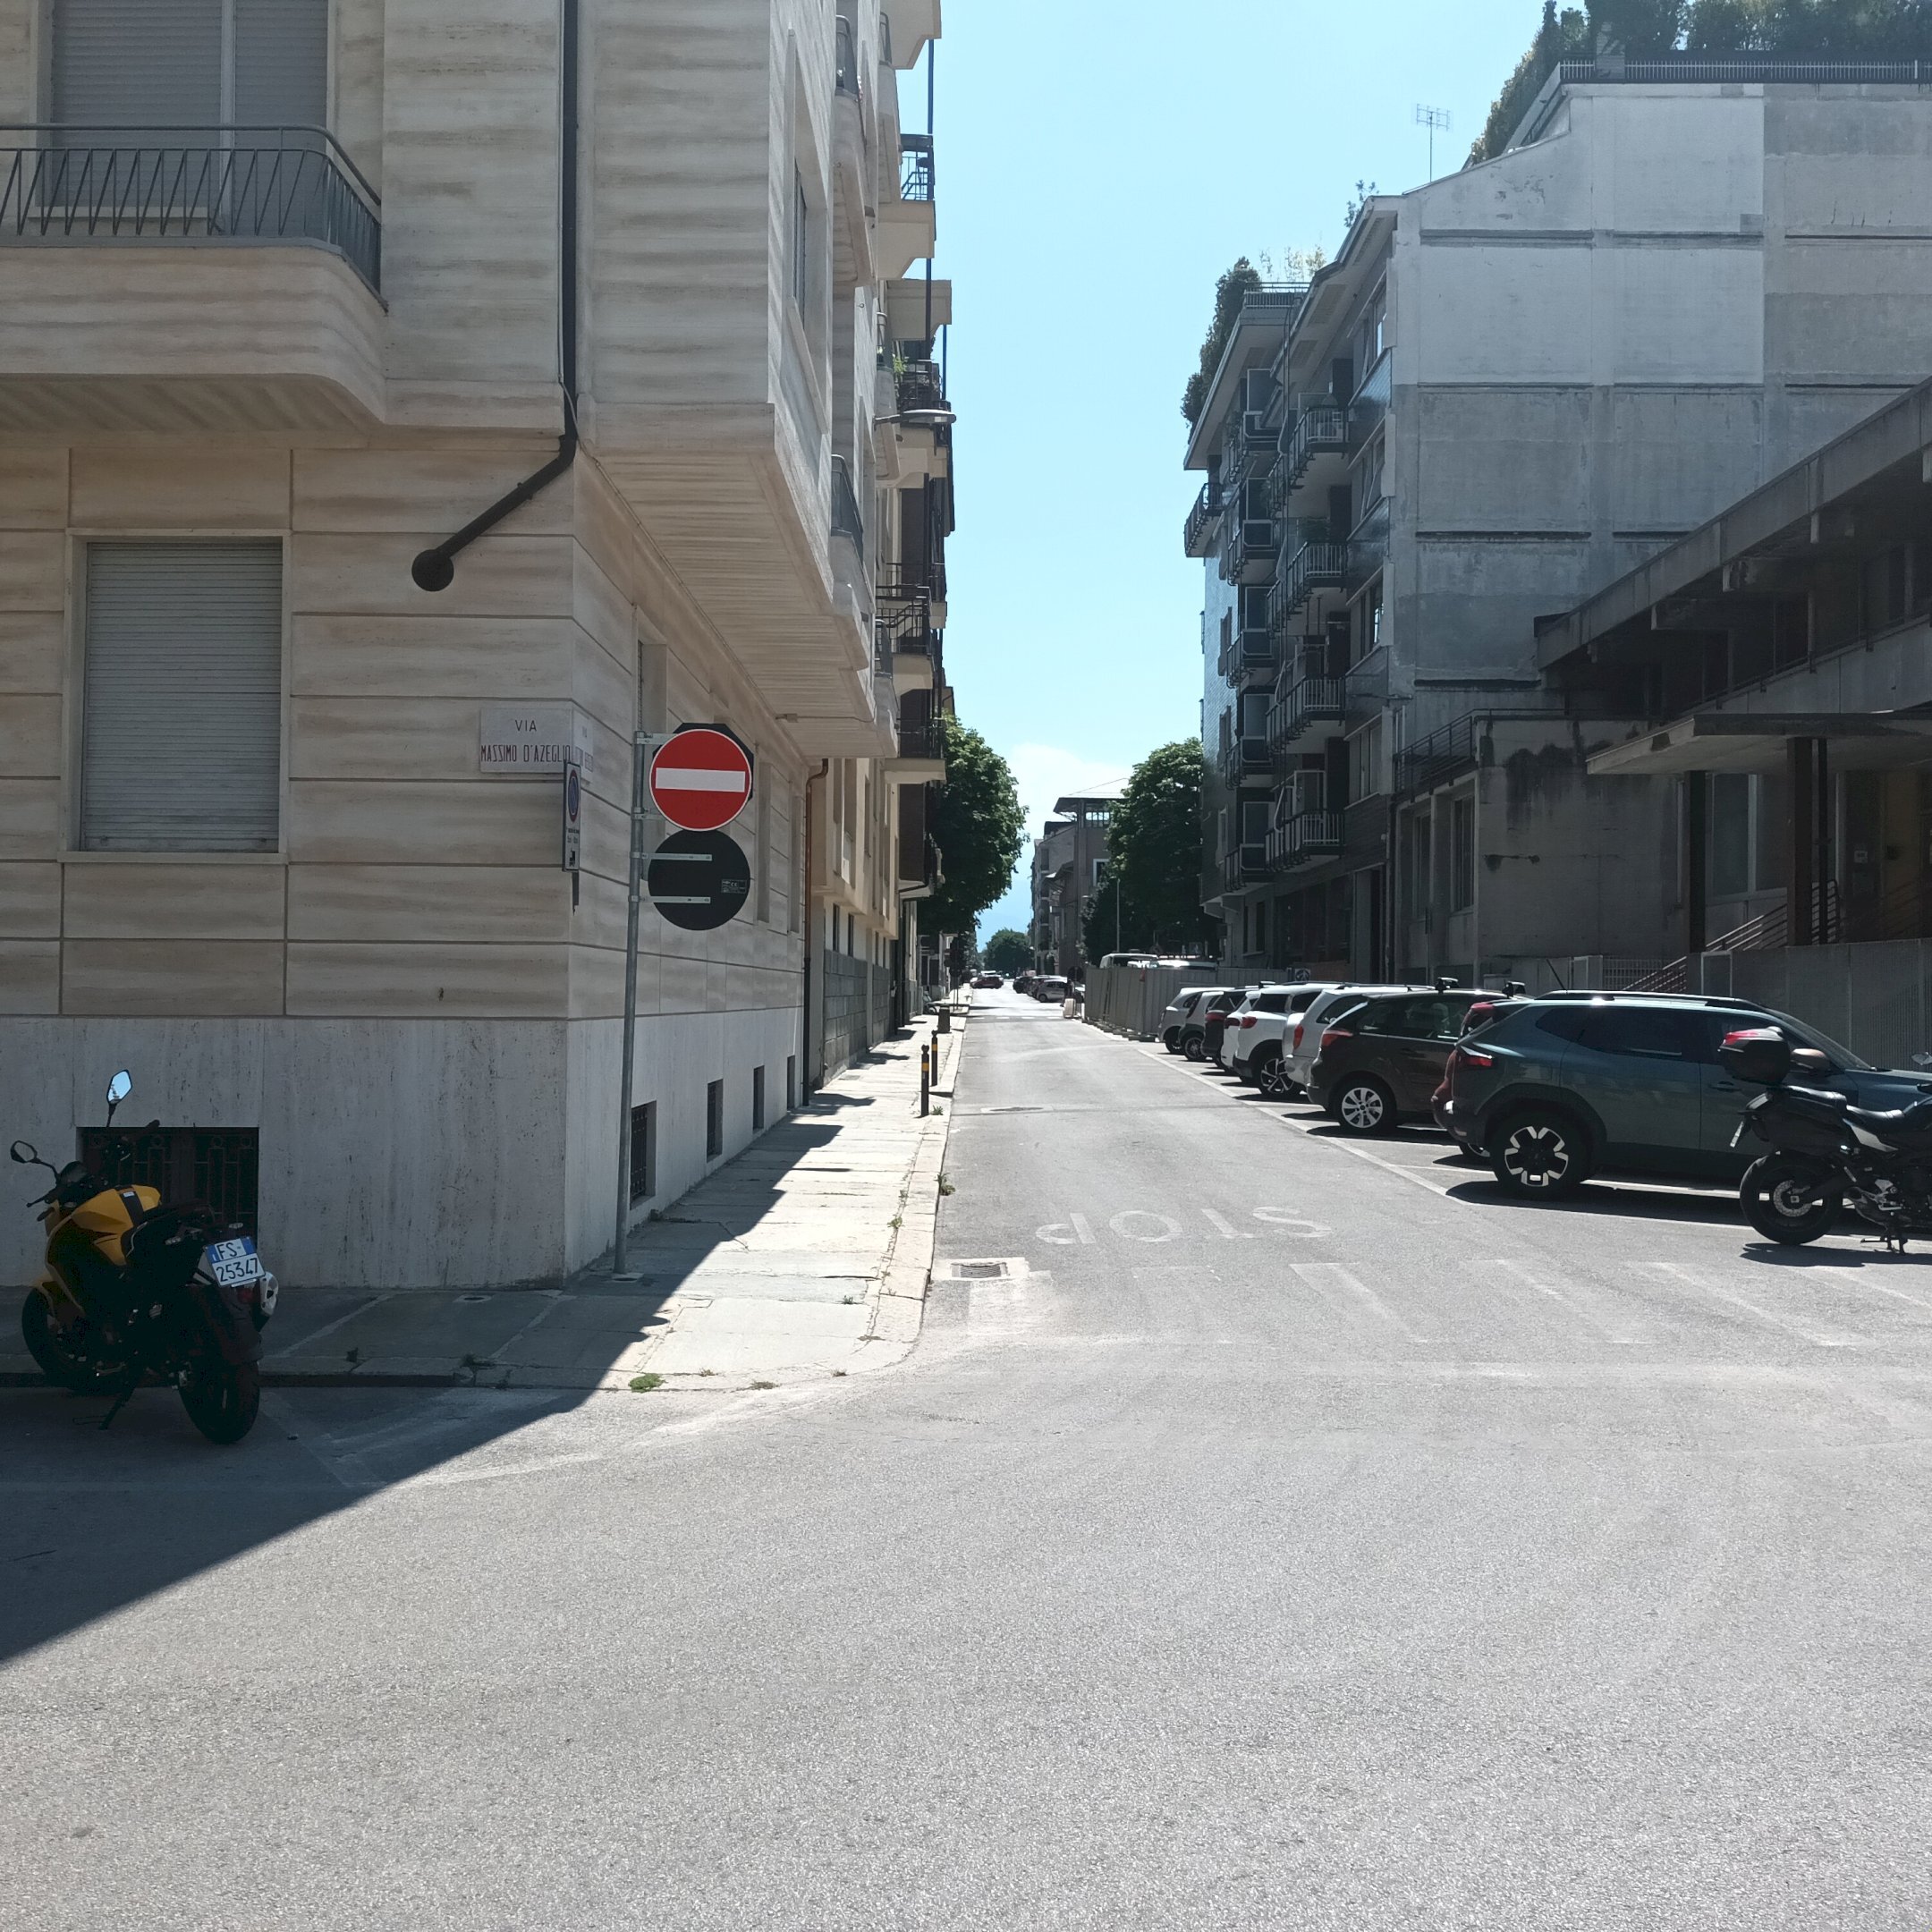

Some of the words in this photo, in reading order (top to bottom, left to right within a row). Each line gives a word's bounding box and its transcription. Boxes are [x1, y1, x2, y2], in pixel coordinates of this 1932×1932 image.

[514, 719, 537, 732] VIA
[480, 744, 517, 762] MASSIMO
[523, 744, 571, 763] D'AZEGLIO
[1035, 1206, 1334, 1245] STOP
[216, 1241, 237, 1259] FS
[216, 1258, 258, 1282] 25347
